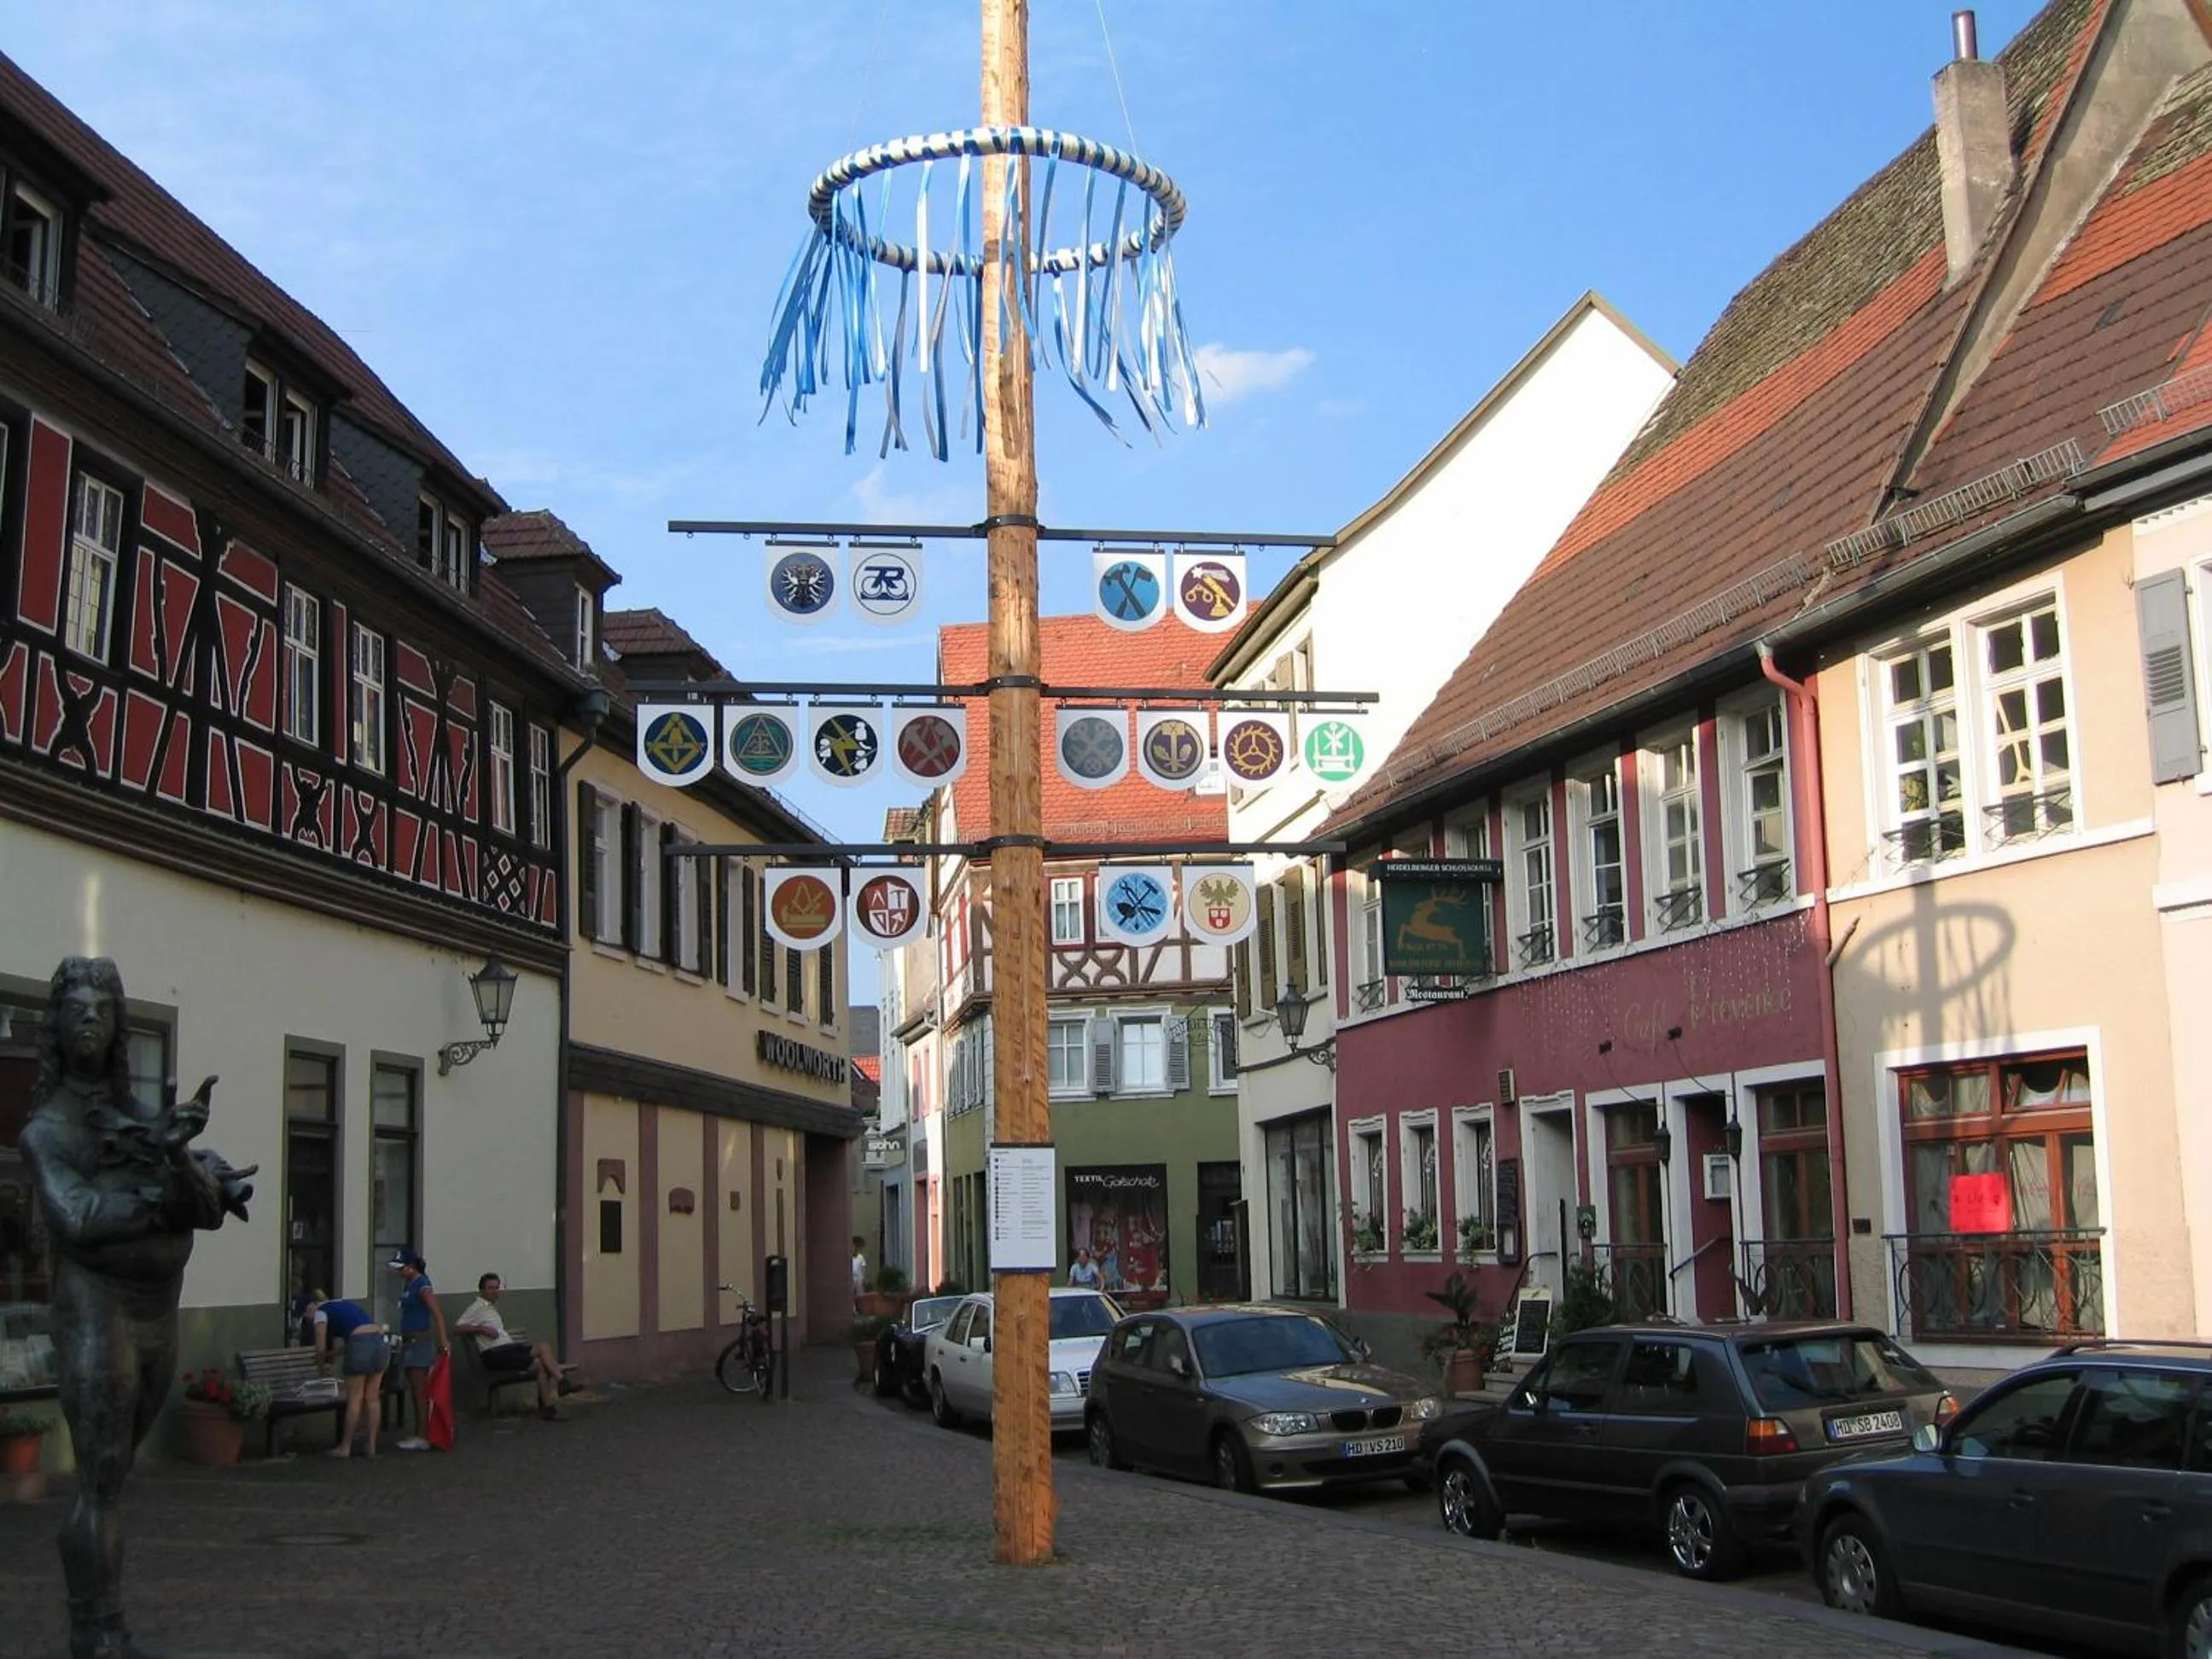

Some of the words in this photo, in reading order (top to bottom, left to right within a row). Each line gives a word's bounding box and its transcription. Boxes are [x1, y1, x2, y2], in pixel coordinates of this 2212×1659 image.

[1406, 988, 1465, 999] Restaurant
[760, 1030, 847, 1083] WOOLWORTH
[1074, 1174, 1102, 1183] TEXTIL
[1347, 1442, 1363, 1455] HD
[1369, 1440, 1382, 1452] VS
[1385, 1437, 1404, 1450] 210
